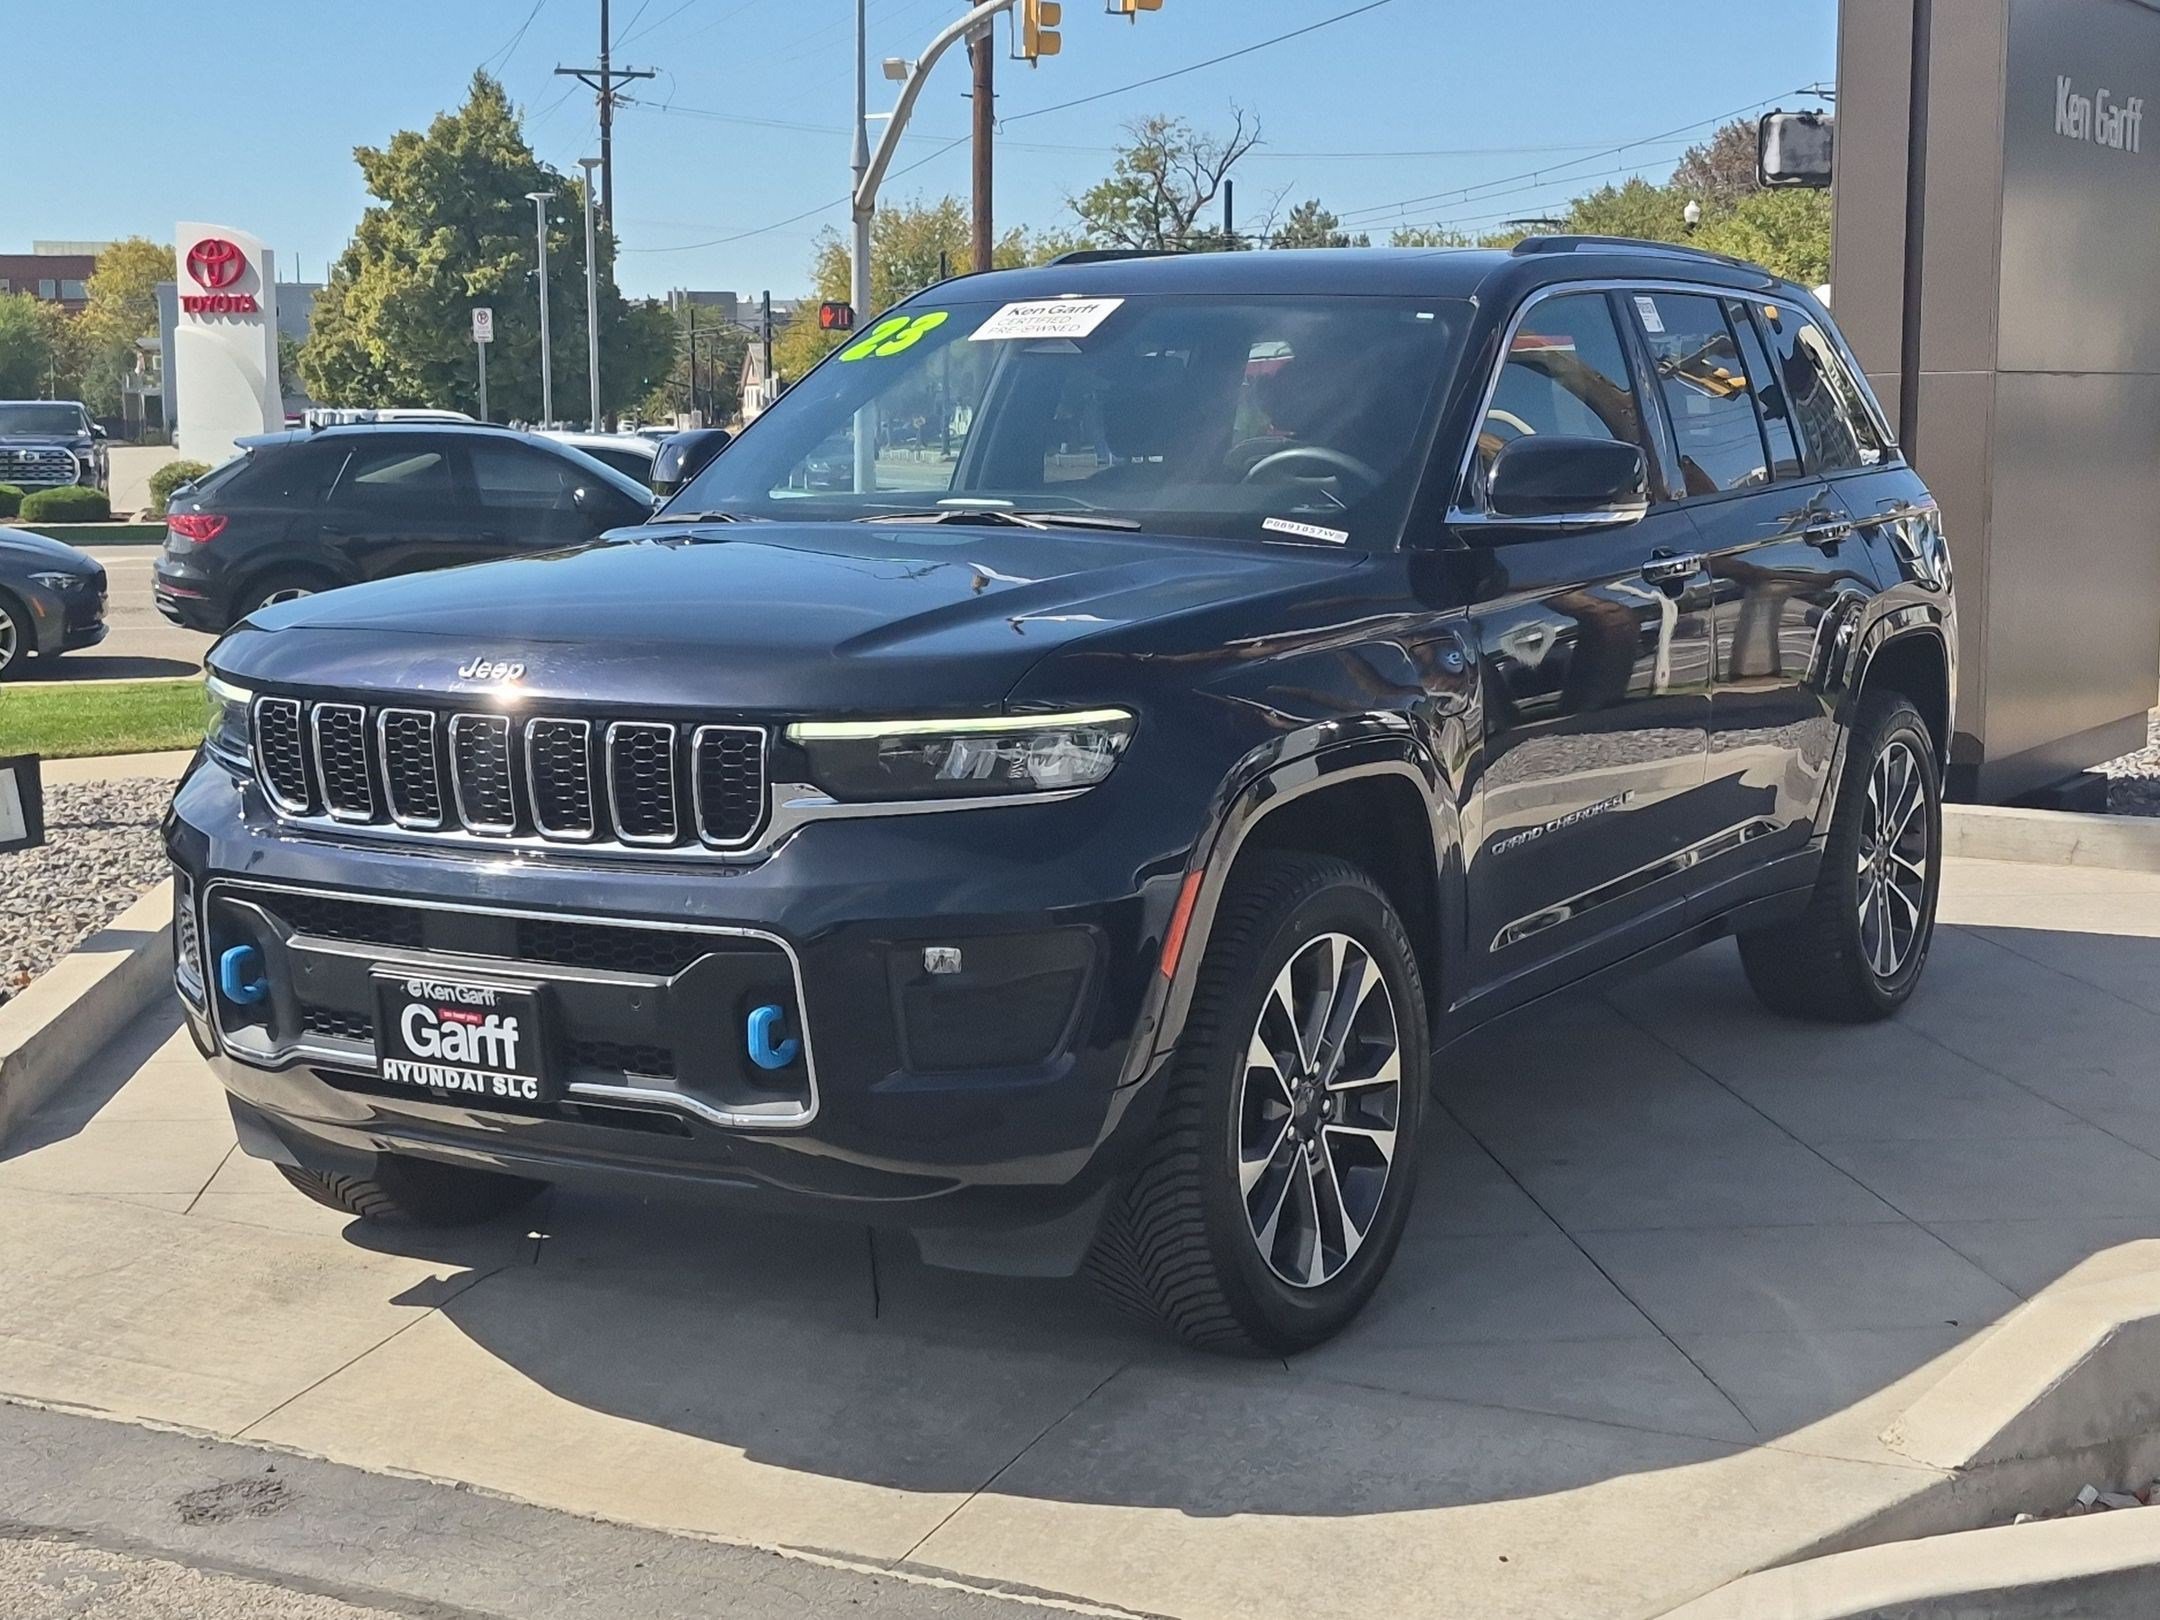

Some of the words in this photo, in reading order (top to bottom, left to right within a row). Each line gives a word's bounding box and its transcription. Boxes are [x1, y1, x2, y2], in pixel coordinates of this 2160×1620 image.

[2055, 74, 2090, 141] Ken
[2094, 87, 2144, 153] Garff
[180, 294, 258, 313] TOYOTA
[1007, 306, 1046, 316] Ken
[997, 316, 1072, 326] CERTIFIED
[838, 311, 949, 362] 23
[458, 656, 526, 681] Jeep
[1491, 826, 1543, 856] GRAND
[401, 1003, 519, 1070] Garff
[382, 1059, 485, 1093] HYUNDAI
[492, 1076, 538, 1099] SLC
